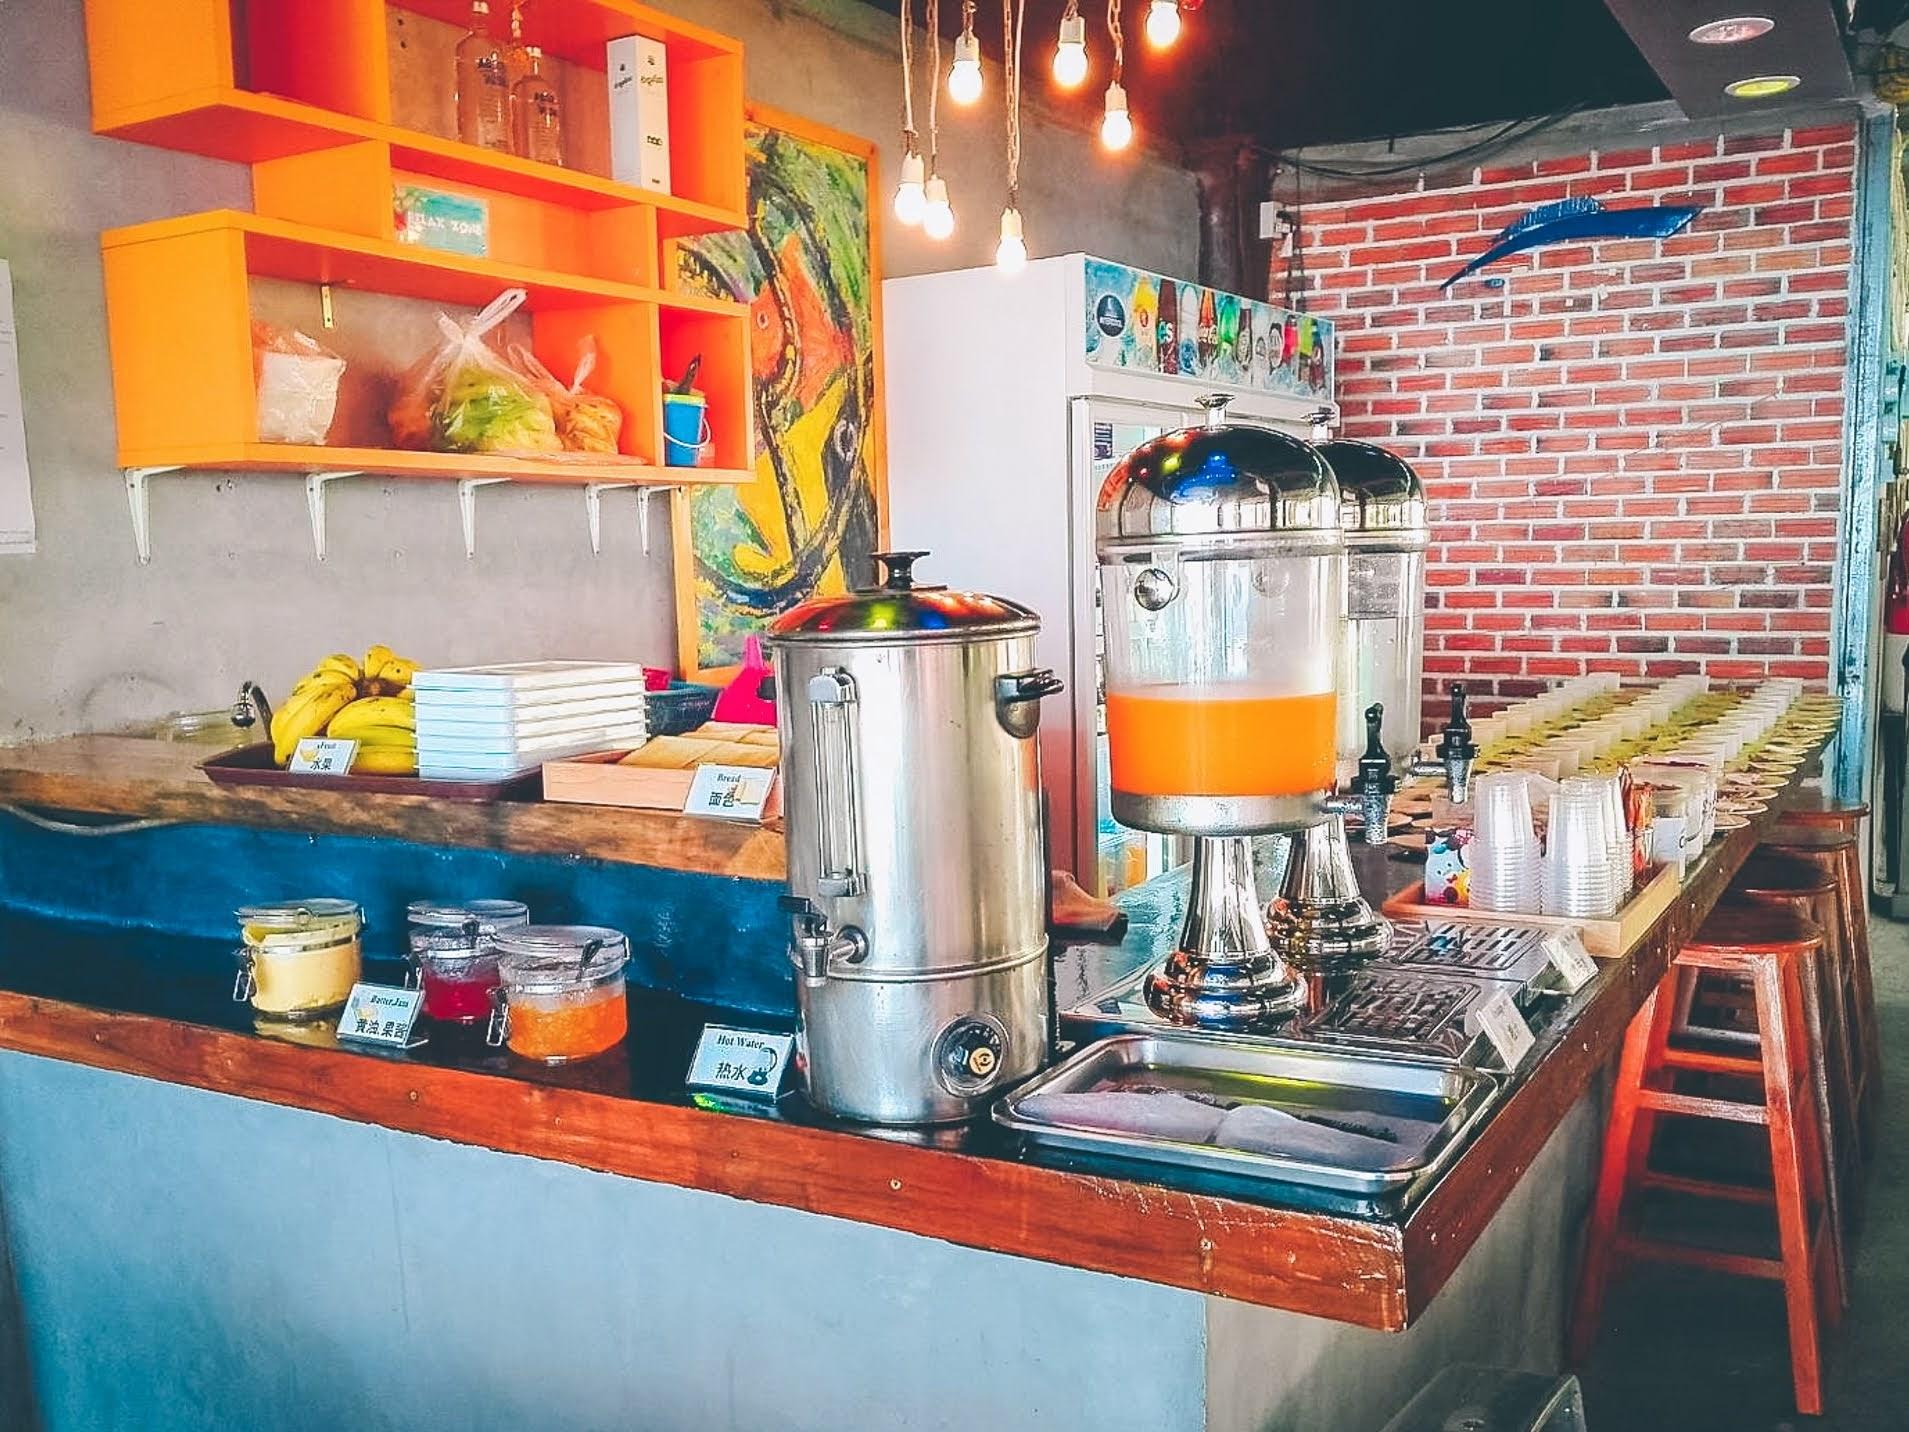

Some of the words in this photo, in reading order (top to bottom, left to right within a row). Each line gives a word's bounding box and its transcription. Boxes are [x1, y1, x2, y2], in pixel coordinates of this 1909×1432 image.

[716, 773, 742, 783] Bread
[708, 791, 735, 808] 面包
[716, 1034, 735, 1046] Hot
[737, 1037, 766, 1049] Water
[715, 1061, 748, 1081] 热水
